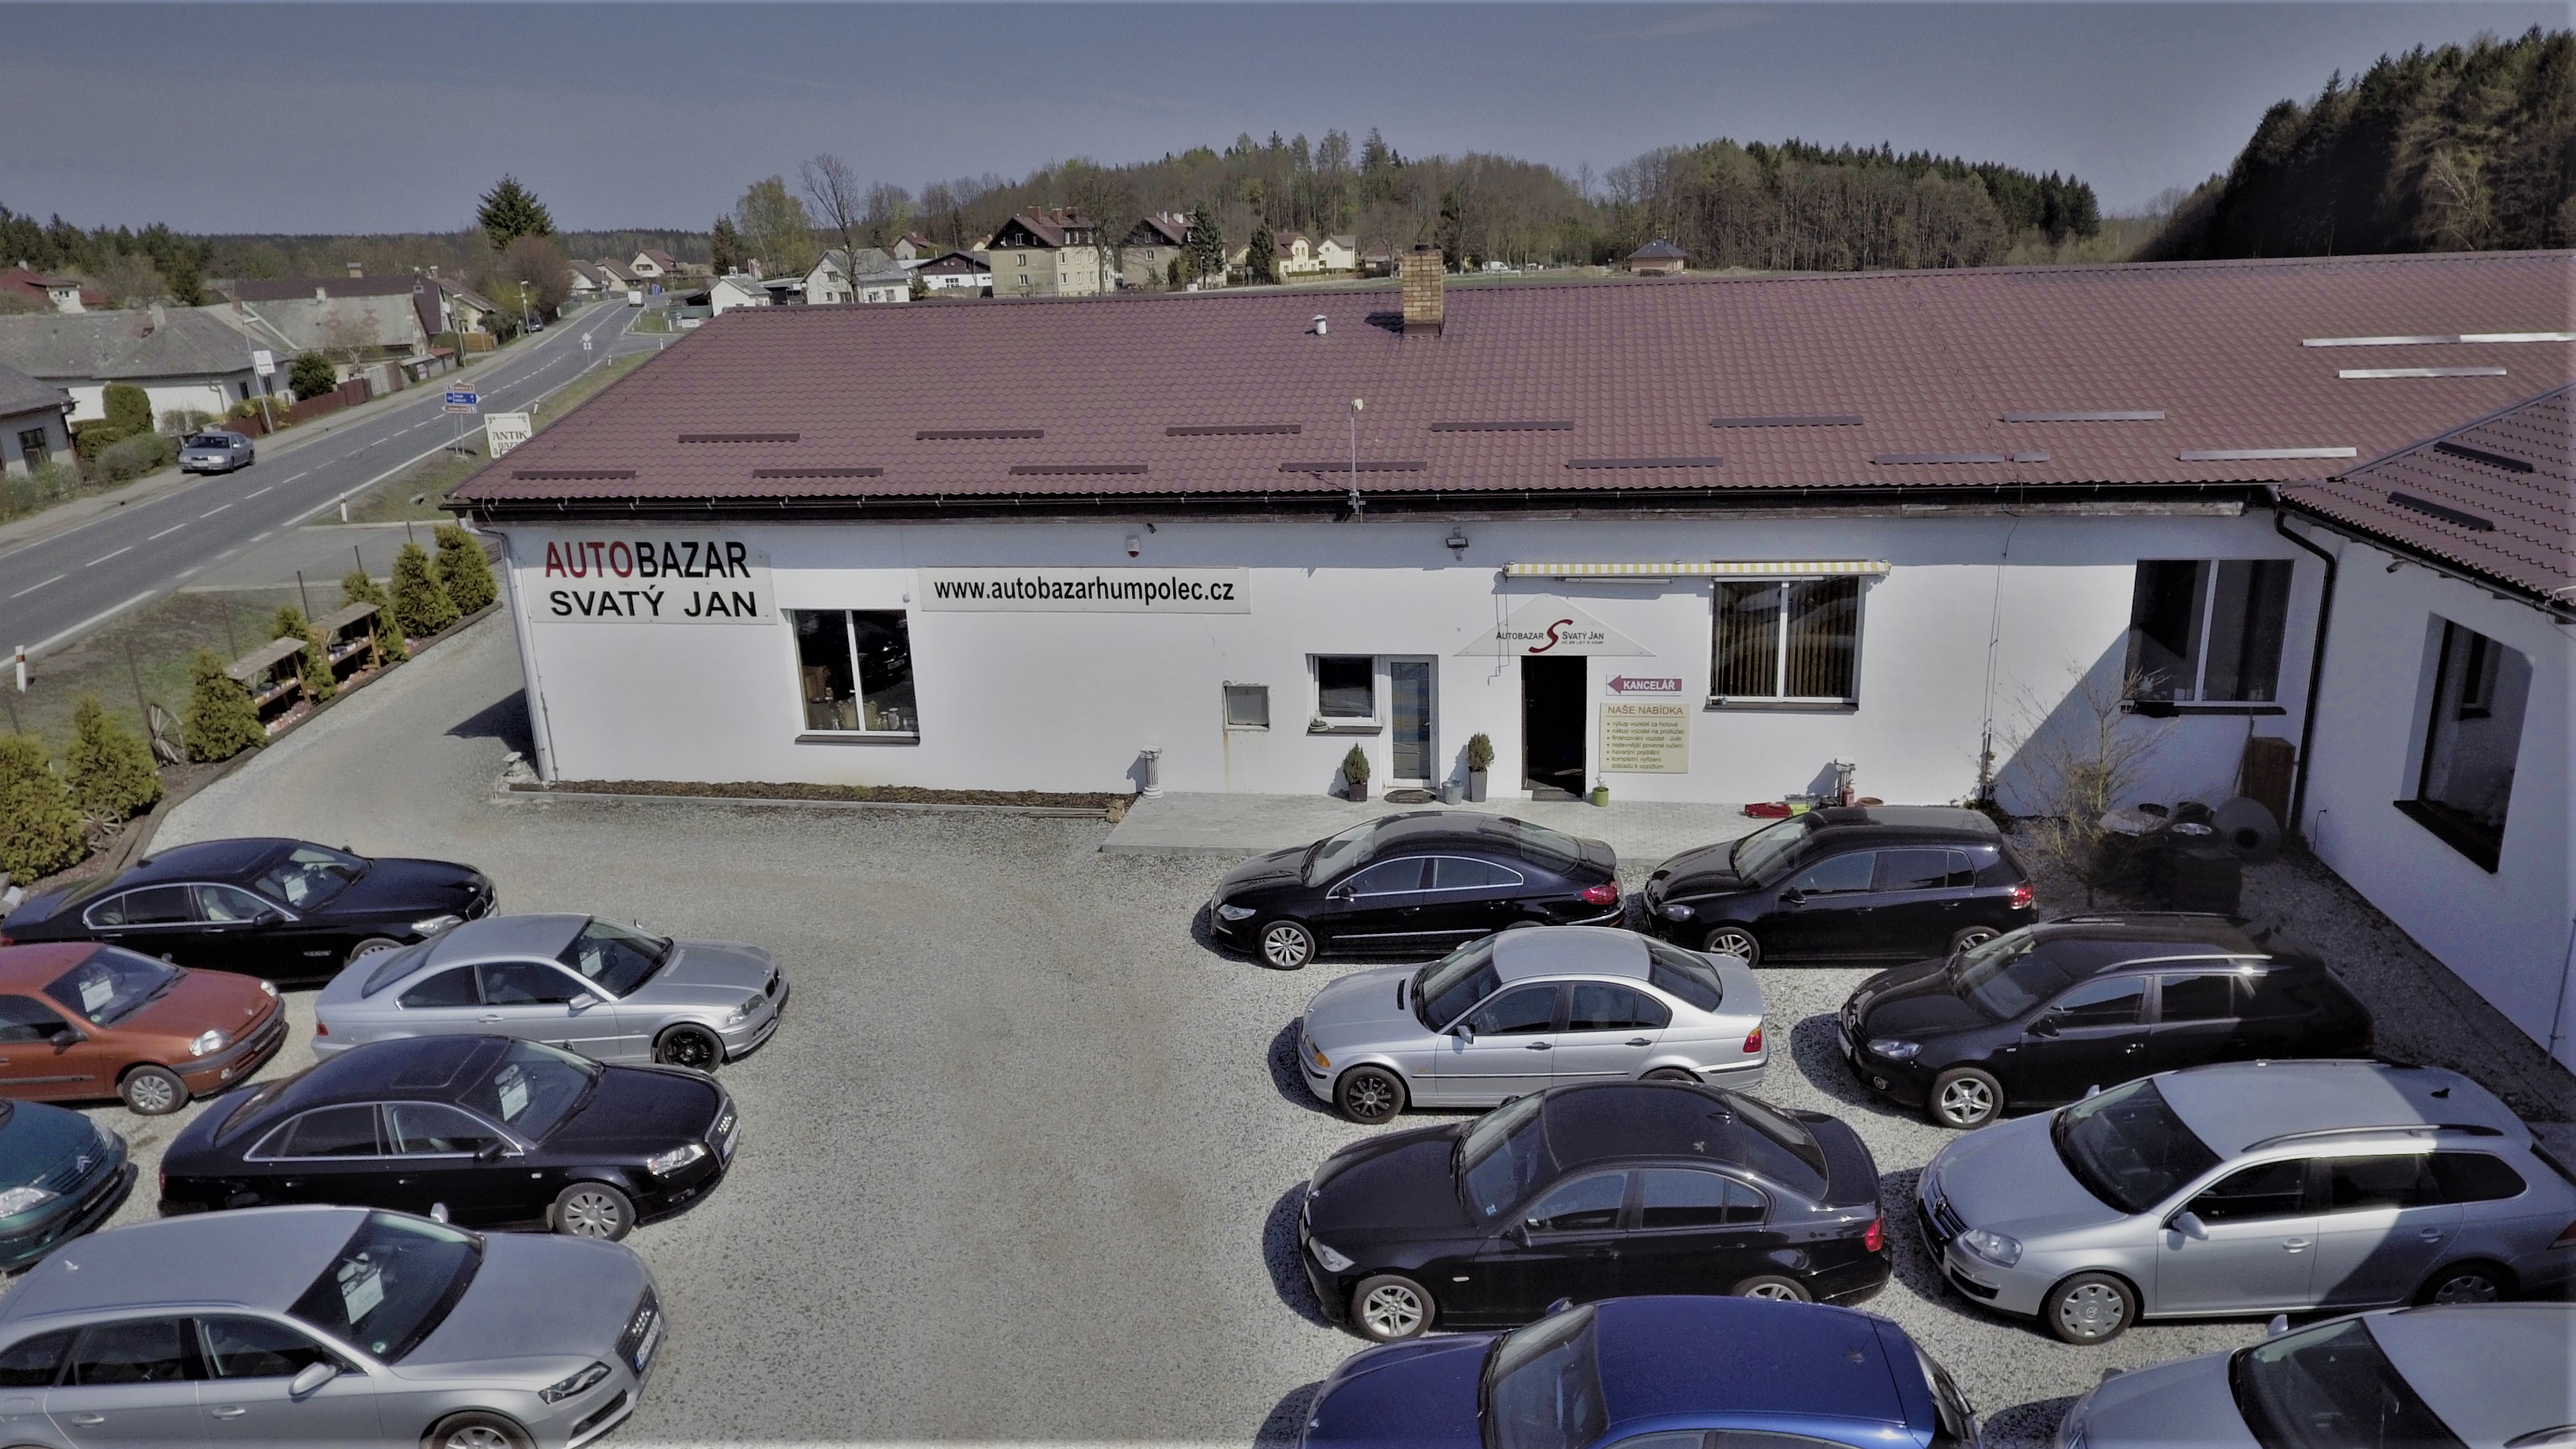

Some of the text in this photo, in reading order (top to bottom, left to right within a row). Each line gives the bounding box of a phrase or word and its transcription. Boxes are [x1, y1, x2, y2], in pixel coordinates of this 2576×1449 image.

[492, 430, 527, 441] ANTIK
[545, 541, 751, 579] AUTOBAZAR
[934, 576, 1234, 606] www.autobazarhumpolec.cz
[550, 585, 757, 618] SVATÝ JAN
[1623, 679, 1676, 690] KANCELÁŘ
[1608, 705, 1684, 715] NAŠE NABÍDKA
